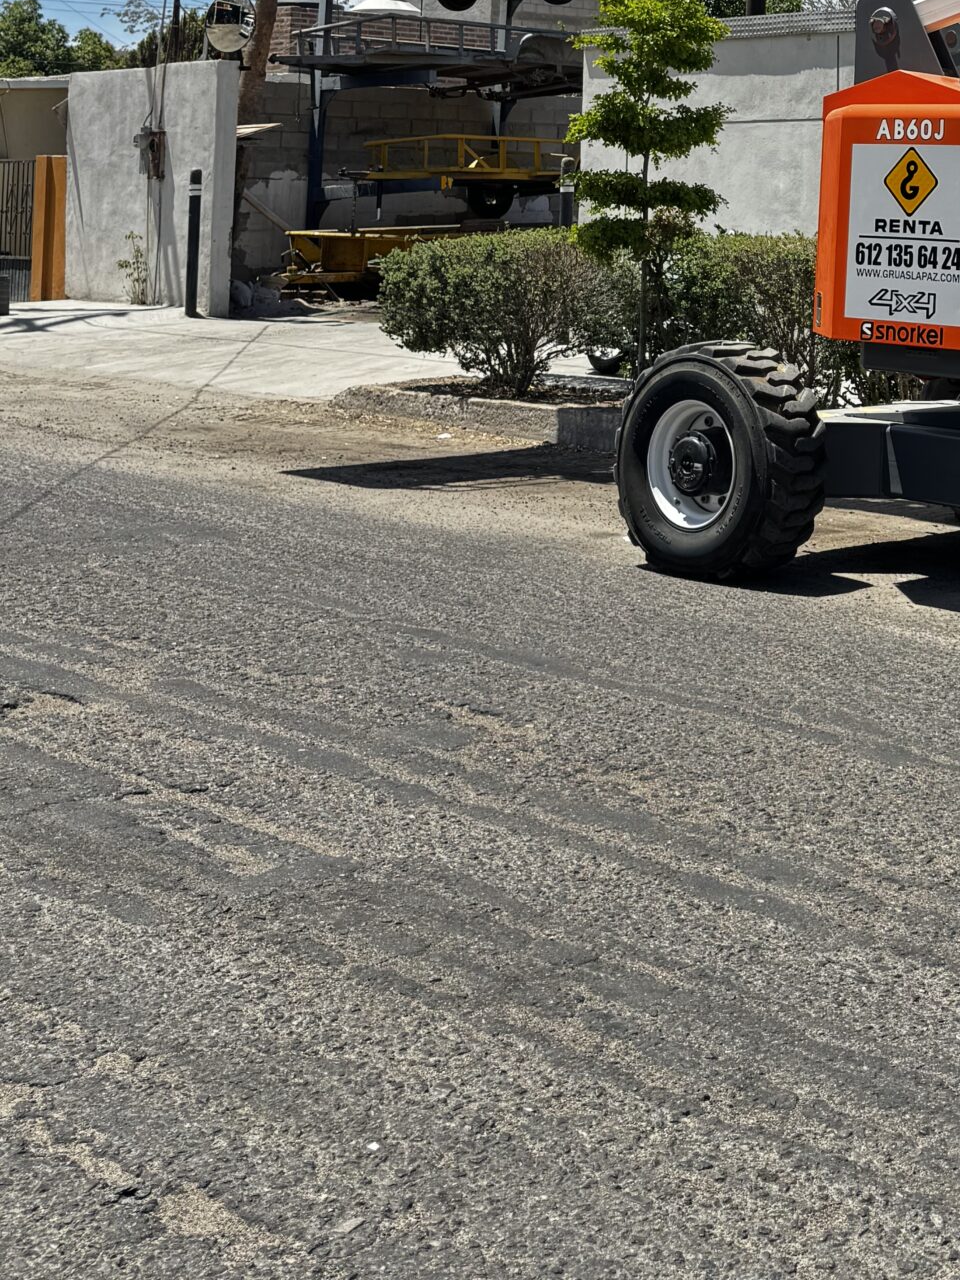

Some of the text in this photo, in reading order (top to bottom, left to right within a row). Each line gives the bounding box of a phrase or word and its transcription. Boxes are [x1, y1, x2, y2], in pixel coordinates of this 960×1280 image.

[876, 119, 945, 140] AB60J
[875, 218, 943, 236] RENTA
[855, 242, 882, 266] 612
[886, 243, 914, 268] 135
[917, 245, 938, 269] 64
[856, 268, 960, 283] WWW.GRUASLAPAZ.COM
[875, 324, 944, 345] snorkel
